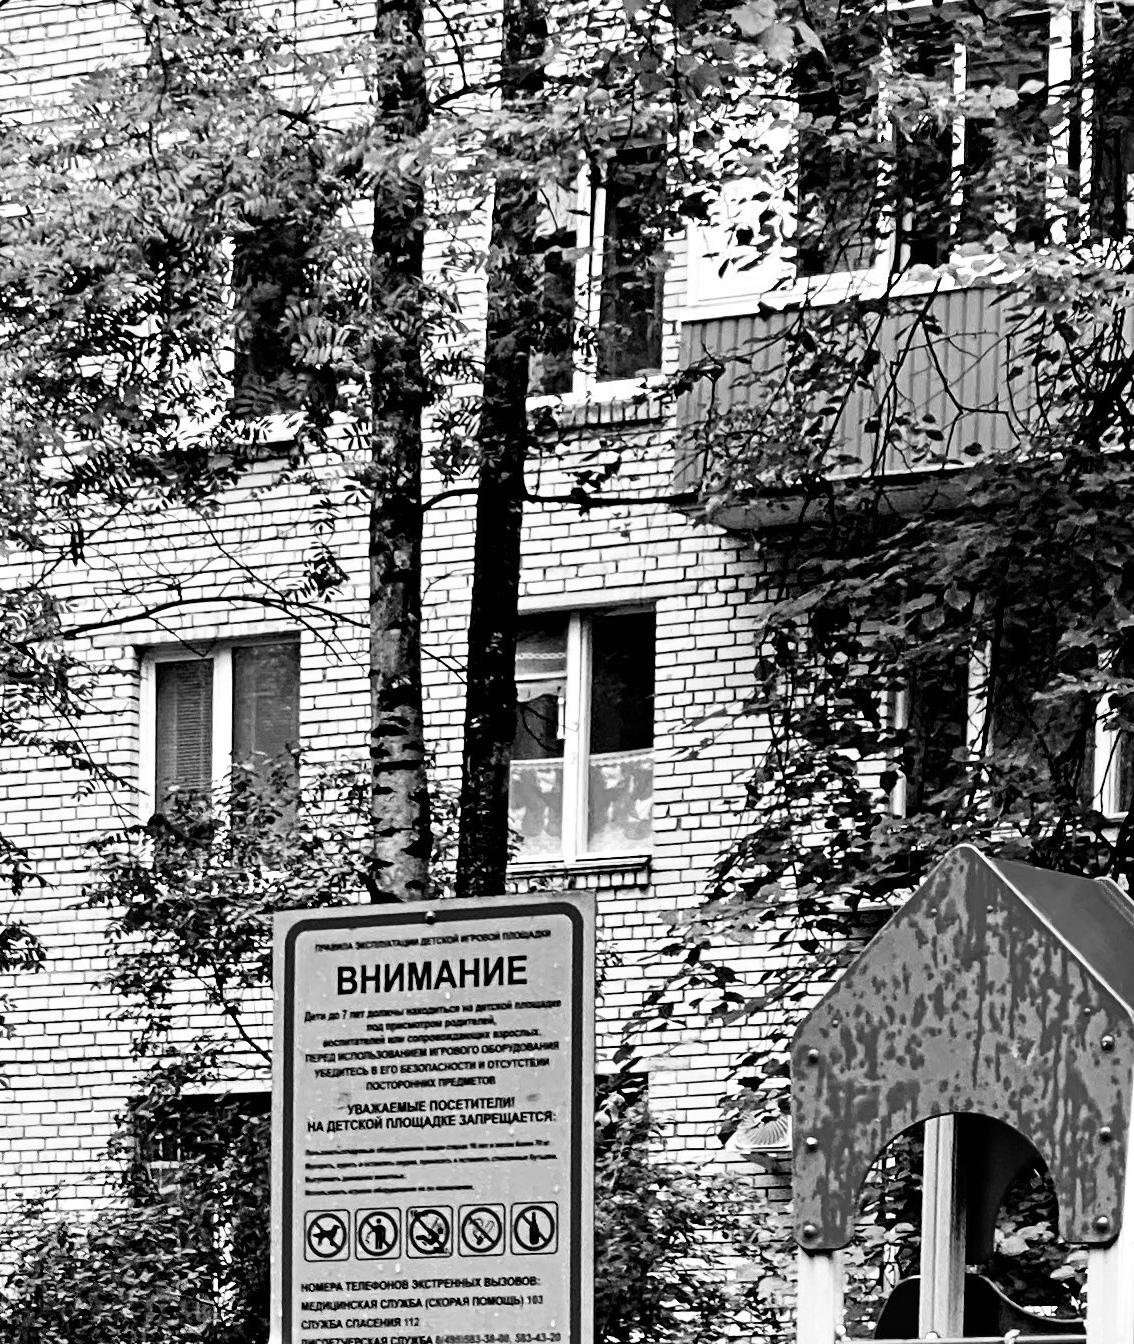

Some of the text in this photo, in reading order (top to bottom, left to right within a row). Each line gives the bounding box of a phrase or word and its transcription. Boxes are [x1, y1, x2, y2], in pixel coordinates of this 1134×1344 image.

[420, 934, 459, 946] ДЕТСКОЙ
[461, 931, 501, 943] ИГРОВОЙ
[502, 929, 551, 941] ПЛОЩАДКИ
[337, 955, 528, 996] ВНИМАНИЕ
[304, 1011, 326, 1023] Дети
[349, 1010, 365, 1019] лет
[366, 1008, 404, 1019] должны
[475, 1000, 513, 1013] детской
[514, 999, 562, 1010] площадке
[366, 1023, 384, 1033] под
[387, 1035, 405, 1044] или
[306, 1041, 560, 1063] ПЕРЕД ИСПОЛЬЗОВАНИЕМ ИГРОВОГО ОБОРУДОВАНИЯ
[314, 1066, 369, 1078] УБЕДИТЕСЬ
[380, 1064, 399, 1075] ЕГО
[400, 1060, 477, 1073] БЕЗОПАСНОСТИ
[487, 1057, 550, 1069] ОТСУТСТВИИ
[366, 1075, 496, 1091] ПОСТОРОННИХ ПРЕДМЕТОВ
[347, 1096, 515, 1115] УВАЖАЕМЫЕ ПОСЕТИТЕЛИ!
[307, 1110, 557, 1134] НА ДЕТСКОЙ ПЛОЩАДКЕ ЗАПРЕЩАЕТСЯ:
[301, 1276, 541, 1293] НОМЕРА ТЕЛЕФОНОВ ЭКСТРЕННЫХ ВЫЗОВОВ:
[301, 1294, 544, 1313] МЕДИЦИНСКАЯ СЛУЖБА (СКОРАЯ ПОМОЩЬ) 103
[301, 1316, 420, 1330] СЛУЖБА СПАСЕНИЯ 112
